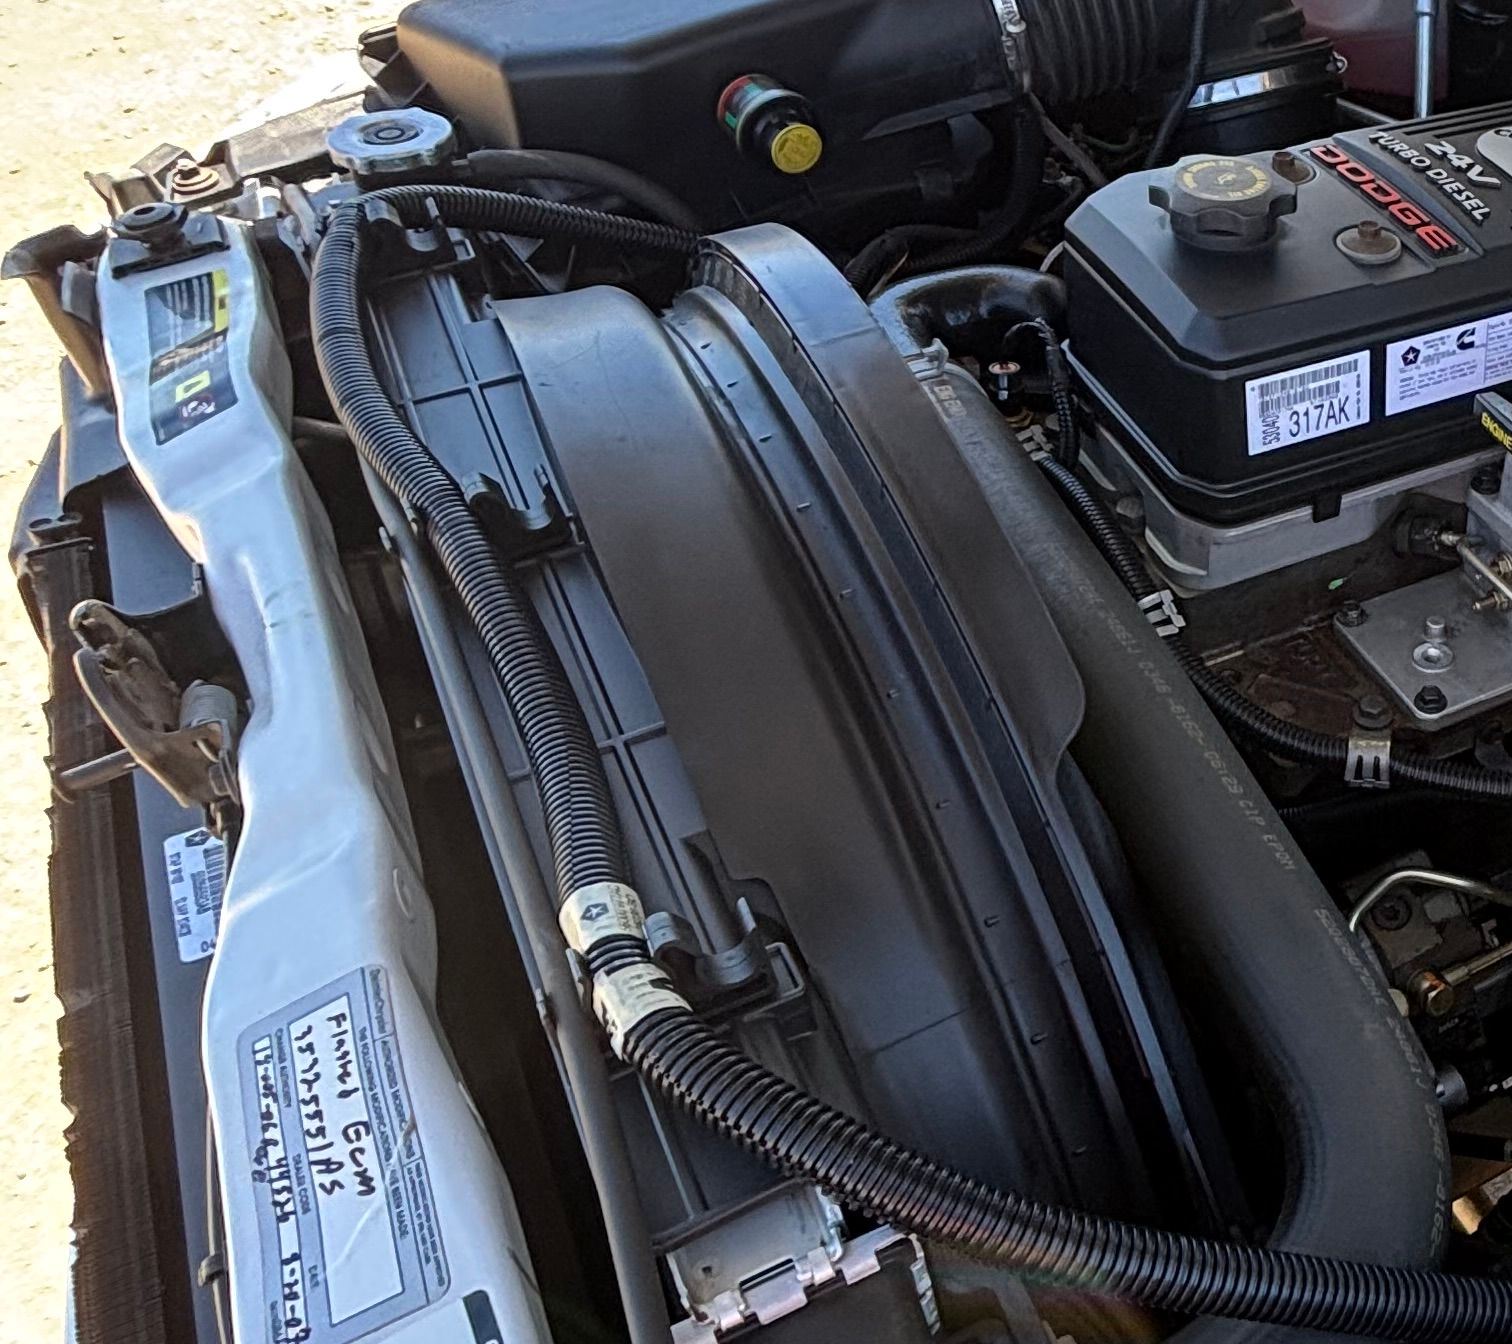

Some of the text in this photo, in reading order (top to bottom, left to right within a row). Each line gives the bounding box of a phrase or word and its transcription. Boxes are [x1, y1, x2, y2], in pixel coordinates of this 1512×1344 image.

[1369, 132, 1491, 222] TURBO DIESEL
[1424, 141, 1502, 187] 24V
[1311, 144, 1456, 250] DODGE
[1289, 396, 1349, 437] 317AK
[1481, 412, 1512, 450] ENGINE
[277, 1063, 294, 1110] AUTHORITY
[359, 1041, 378, 1093] FOLLOWING
[292, 1151, 310, 1216] DEALER CODE
